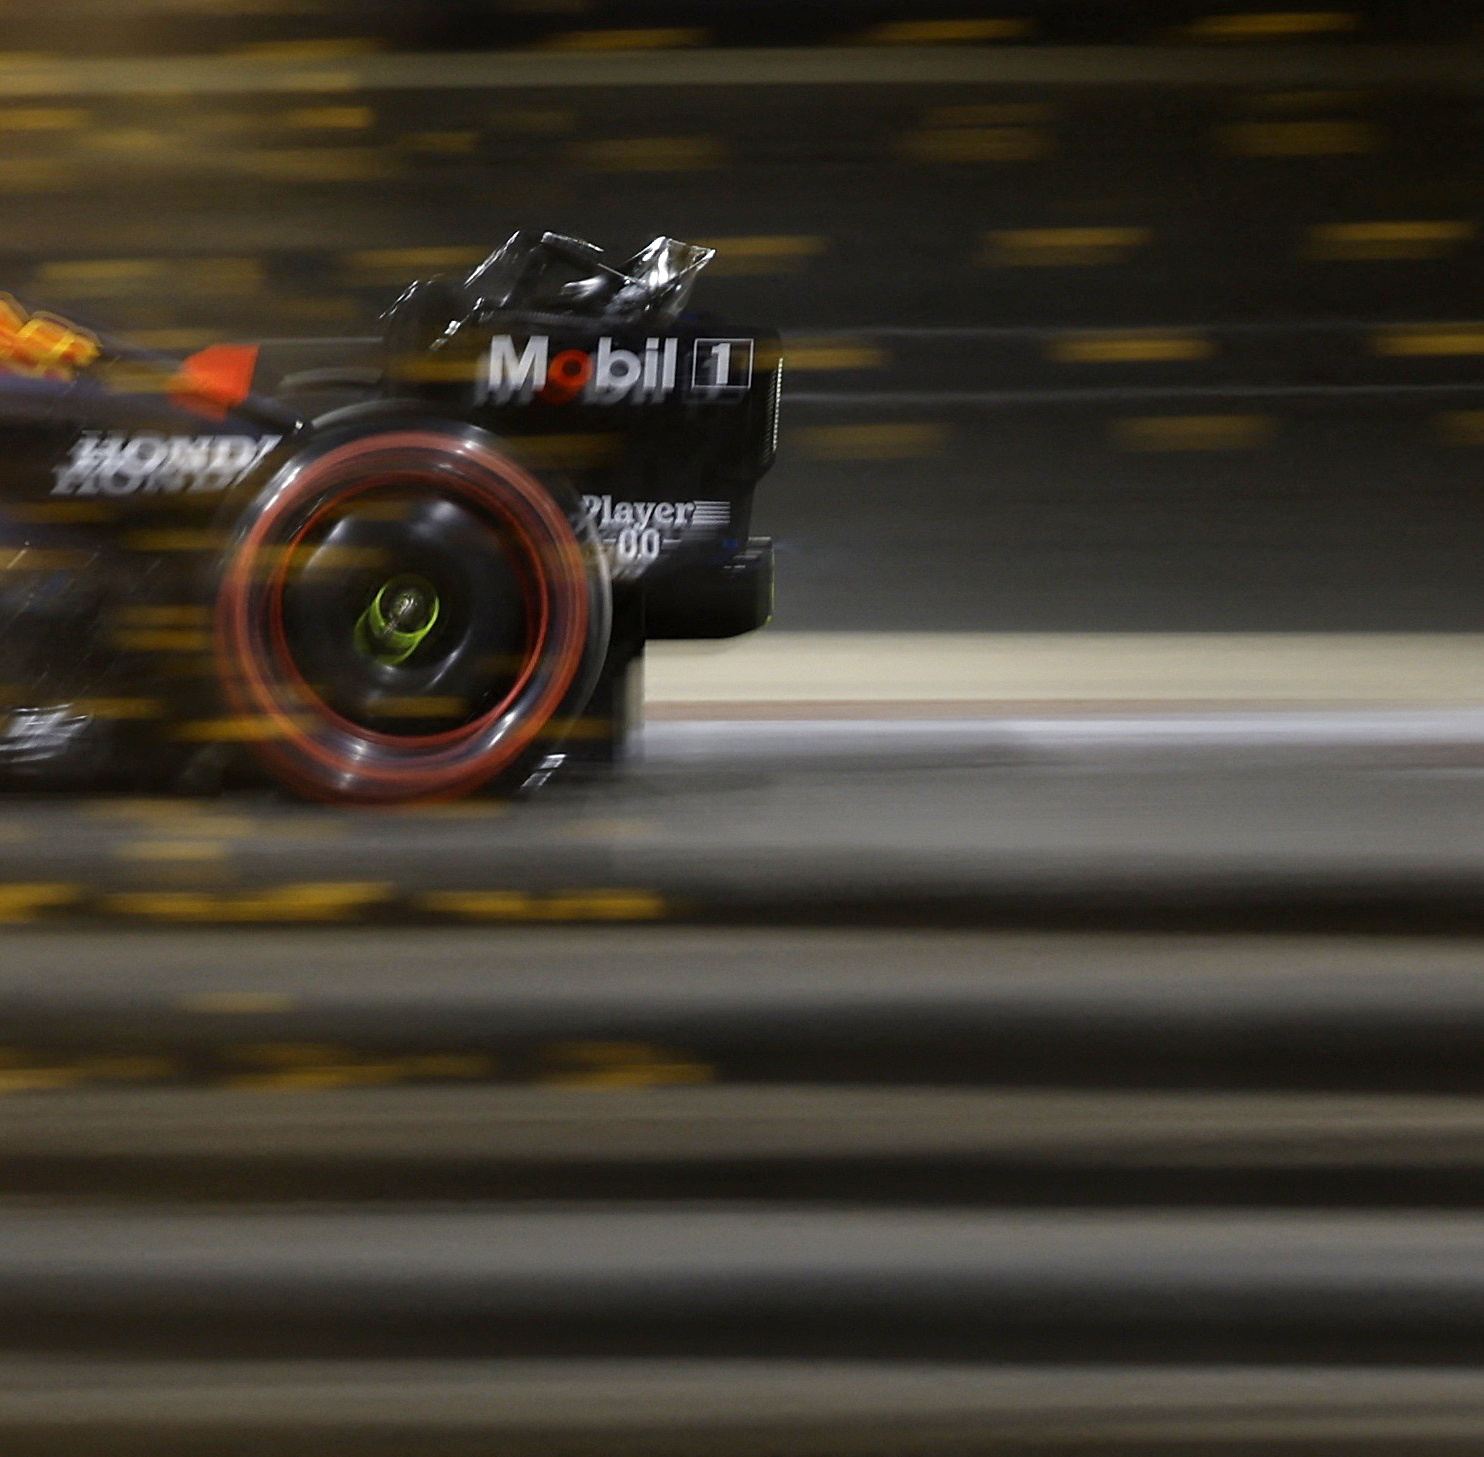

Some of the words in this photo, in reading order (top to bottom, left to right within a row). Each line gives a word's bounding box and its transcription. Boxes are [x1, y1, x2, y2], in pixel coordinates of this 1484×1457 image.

[488, 335, 678, 389] Mobil
[710, 343, 731, 385] 1
[53, 430, 283, 494] HOND
